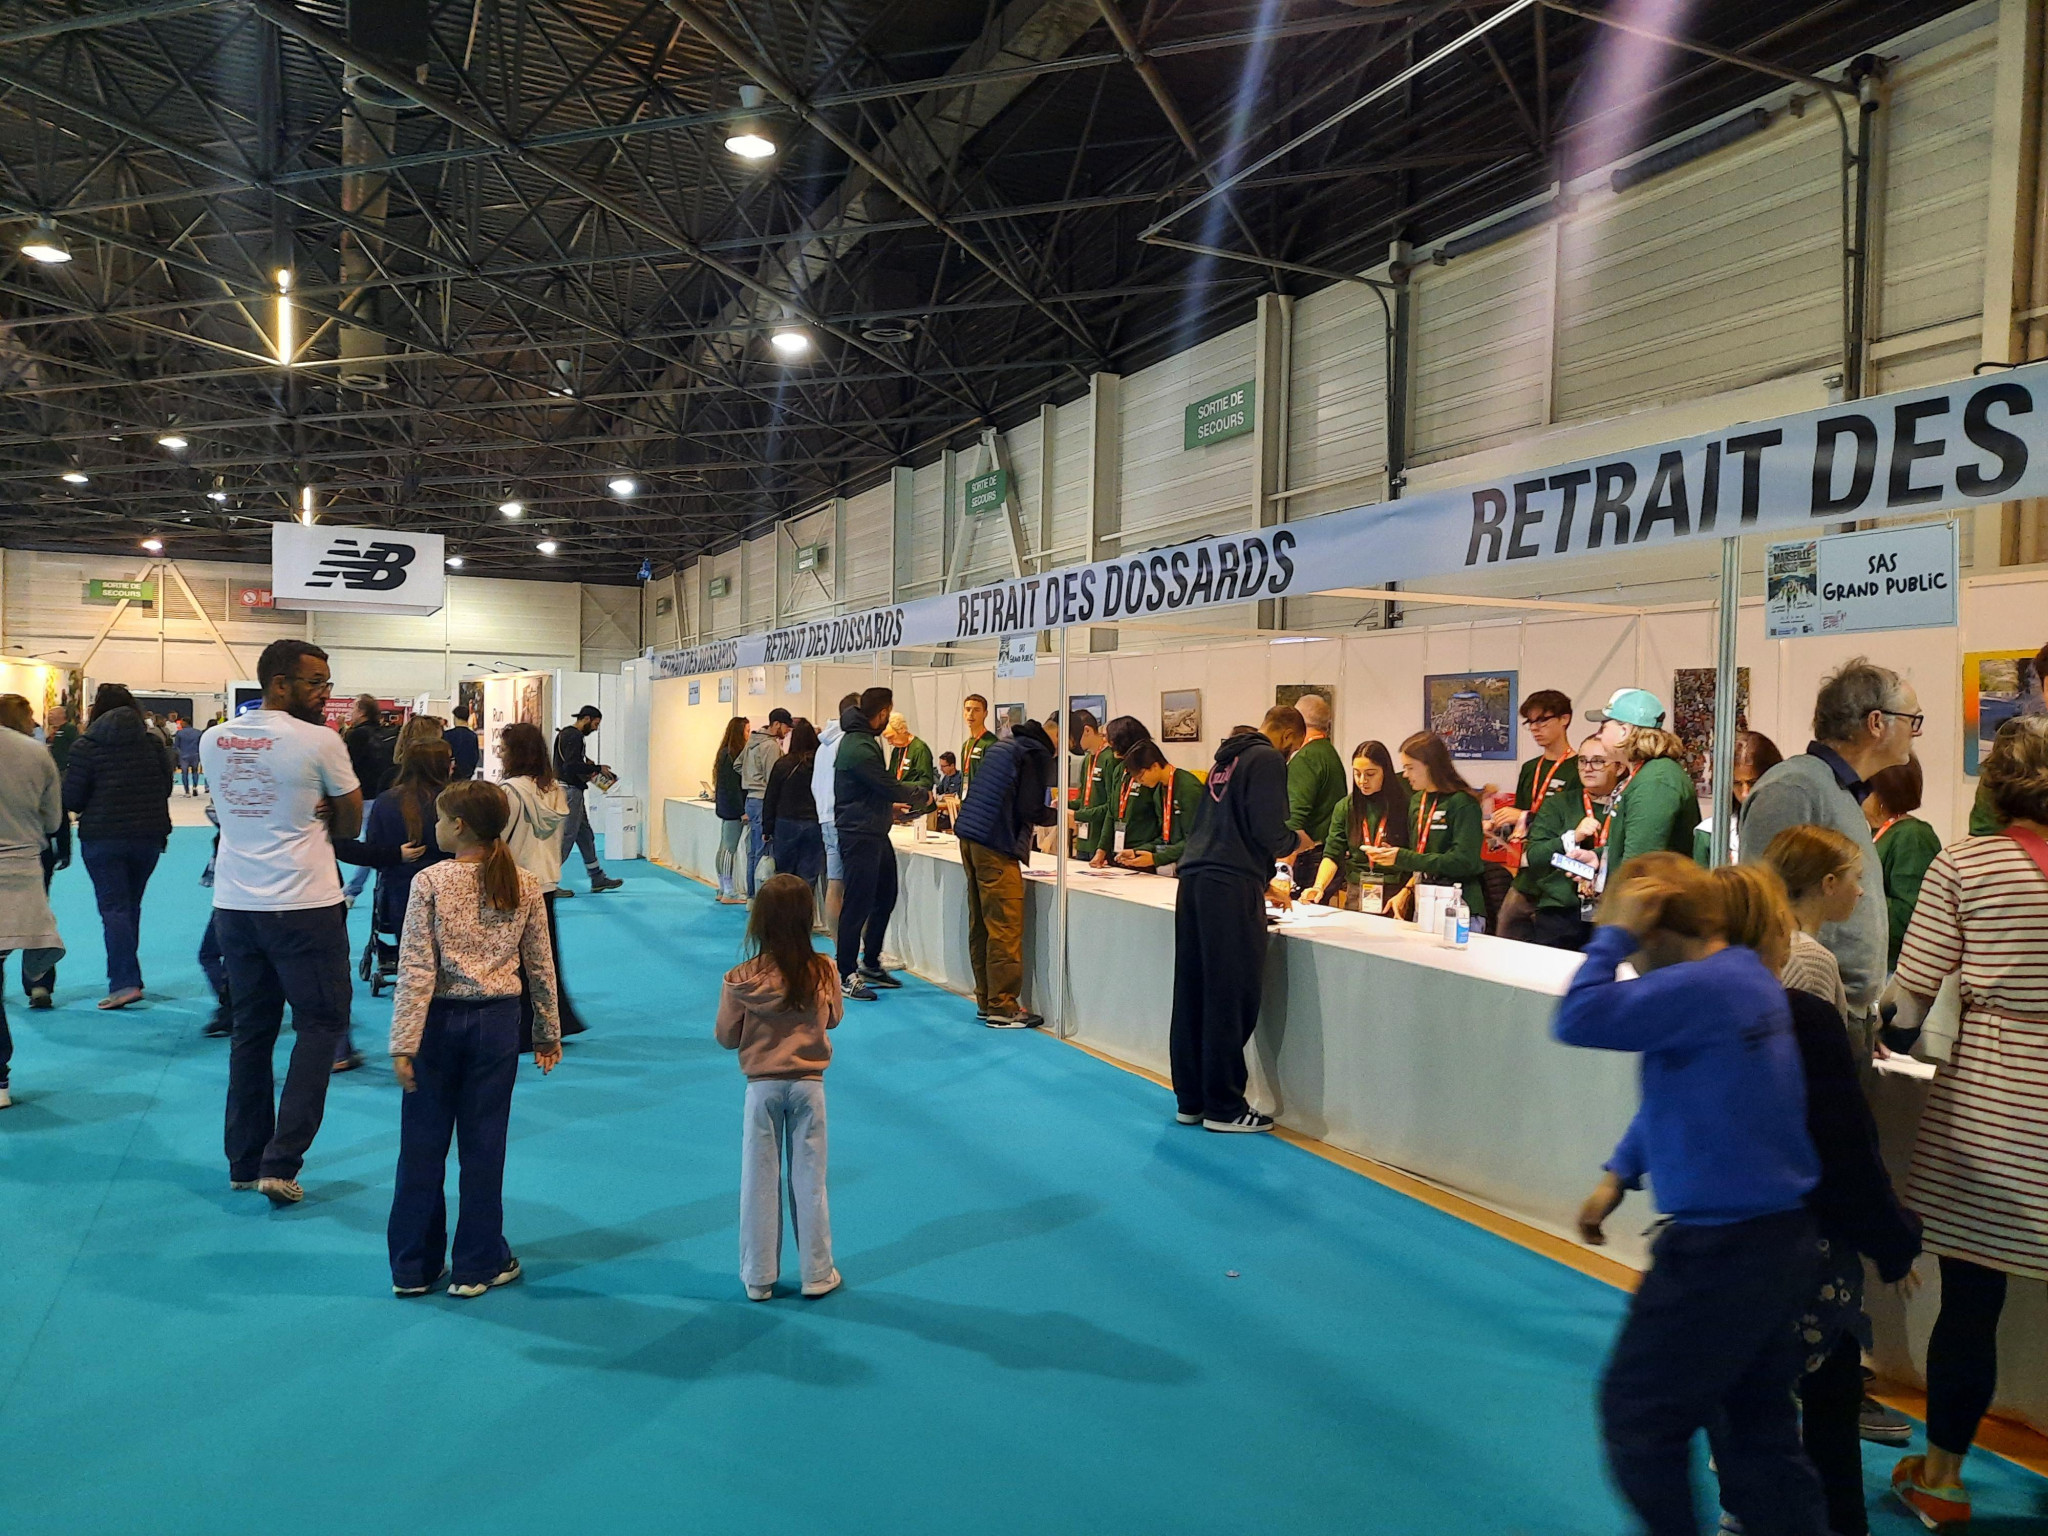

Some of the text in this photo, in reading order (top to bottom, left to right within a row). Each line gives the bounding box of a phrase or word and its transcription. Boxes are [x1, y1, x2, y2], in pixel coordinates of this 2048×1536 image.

[1198, 390, 1244, 419] SORTIE DE
[1198, 411, 1244, 439] SECOURS
[971, 475, 997, 493] SORTIE DE
[1464, 382, 2034, 566] RETRAIT DES
[1868, 553, 1898, 575] SAS
[102, 581, 141, 590] SORTIE DE
[102, 590, 141, 598] SECOURS
[956, 530, 1296, 638] RETRAIT DES DOSSARDS
[1823, 581, 1879, 601] GRAND
[764, 608, 904, 663] RETRAIT DES DOSSARDS
[493, 708, 503, 722] Run
